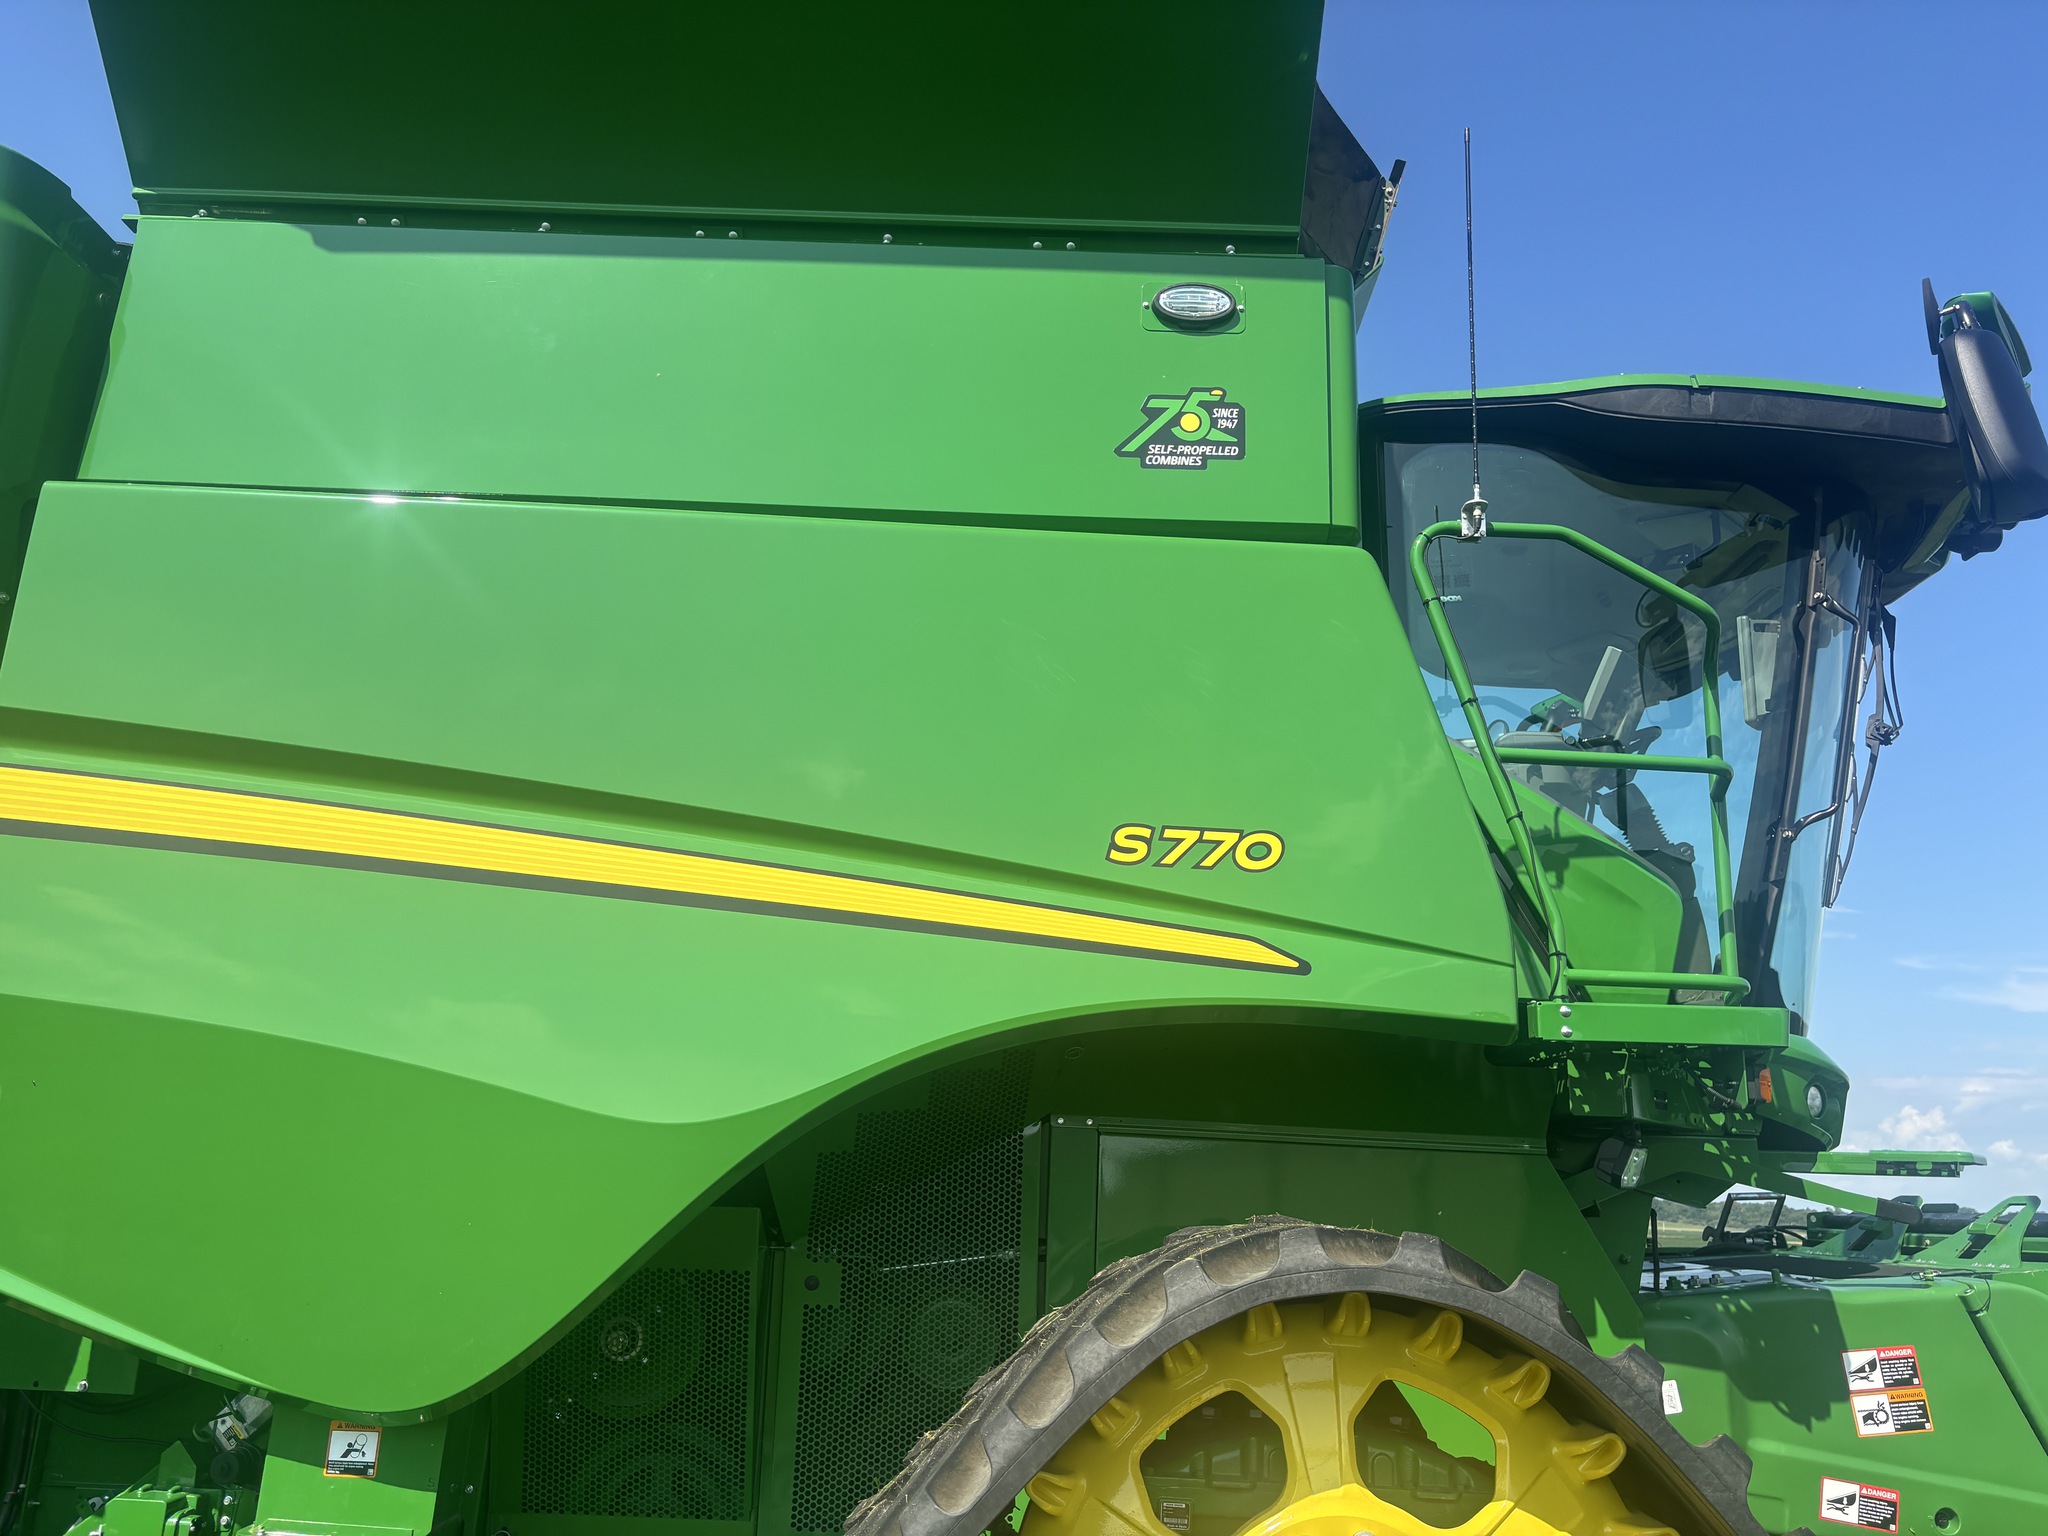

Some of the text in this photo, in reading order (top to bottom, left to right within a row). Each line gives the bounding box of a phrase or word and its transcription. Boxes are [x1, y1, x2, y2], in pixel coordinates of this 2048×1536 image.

[1212, 408, 1239, 418] SINCE
[1120, 391, 1222, 452] 75
[1217, 418, 1238, 429] 1947
[1147, 444, 1239, 456] SELF-PROPELLED
[1145, 455, 1203, 466] COMBINES
[1106, 824, 1284, 872] S770
[1885, 1348, 1912, 1357] DANGER
[1895, 1392, 1924, 1400] WARNING
[1867, 1488, 1897, 1500] DANGER
